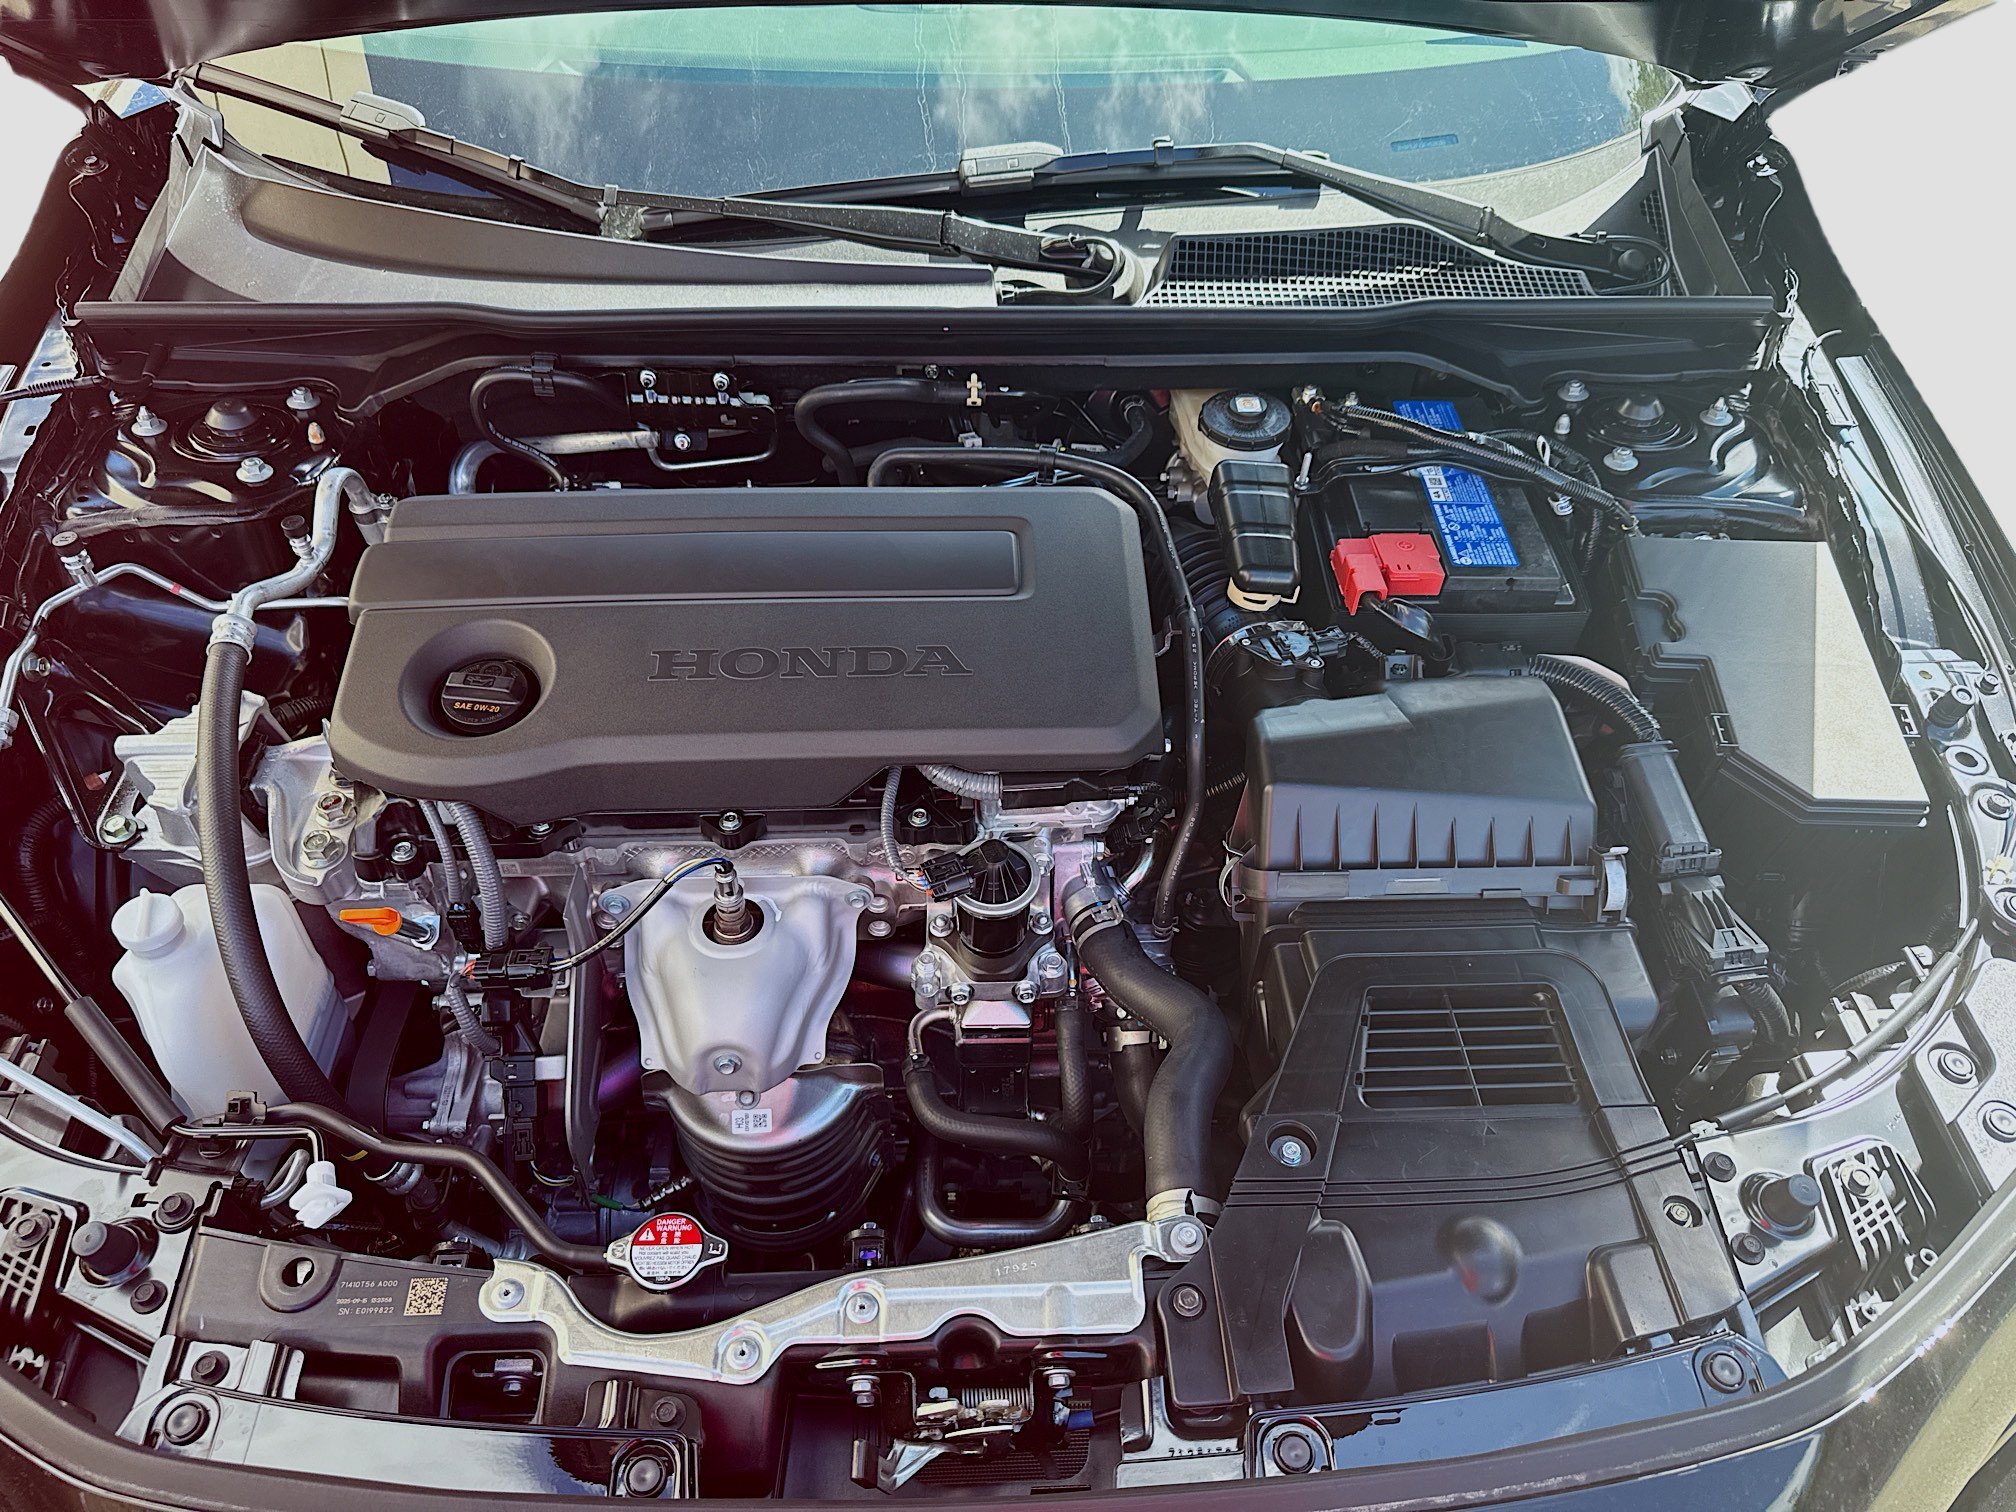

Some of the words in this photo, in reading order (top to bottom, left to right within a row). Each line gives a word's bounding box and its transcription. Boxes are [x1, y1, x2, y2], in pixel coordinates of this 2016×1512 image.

[647, 644, 974, 681] HONDA
[453, 702, 472, 711] SAE
[473, 704, 501, 713] 0W-20
[656, 1224, 692, 1232] WARNUNG
[996, 1260, 1036, 1276] 17925
[341, 1281, 375, 1289] 71410T56
[338, 1307, 353, 1316] SN:
[355, 1306, 394, 1315] E0199822
